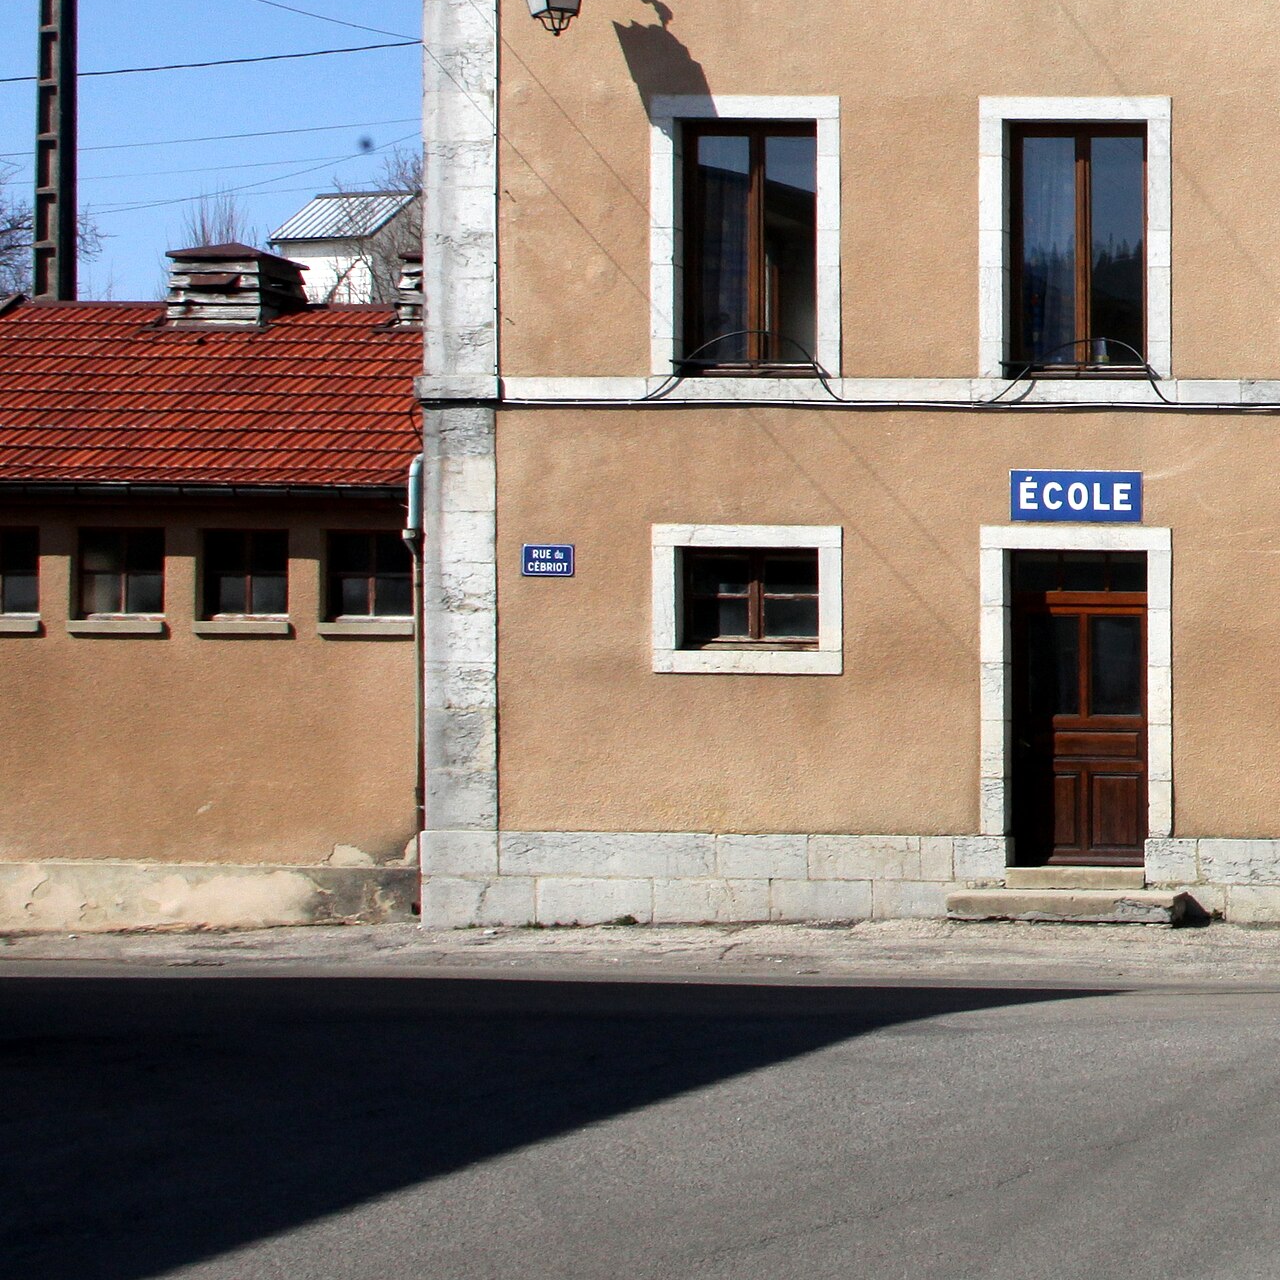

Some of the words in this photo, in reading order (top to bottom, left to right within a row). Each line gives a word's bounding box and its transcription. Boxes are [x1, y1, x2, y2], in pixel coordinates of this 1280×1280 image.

[1019, 476, 1132, 511] ÉCOLE
[532, 549, 552, 559] RUE
[554, 549, 564, 559] du
